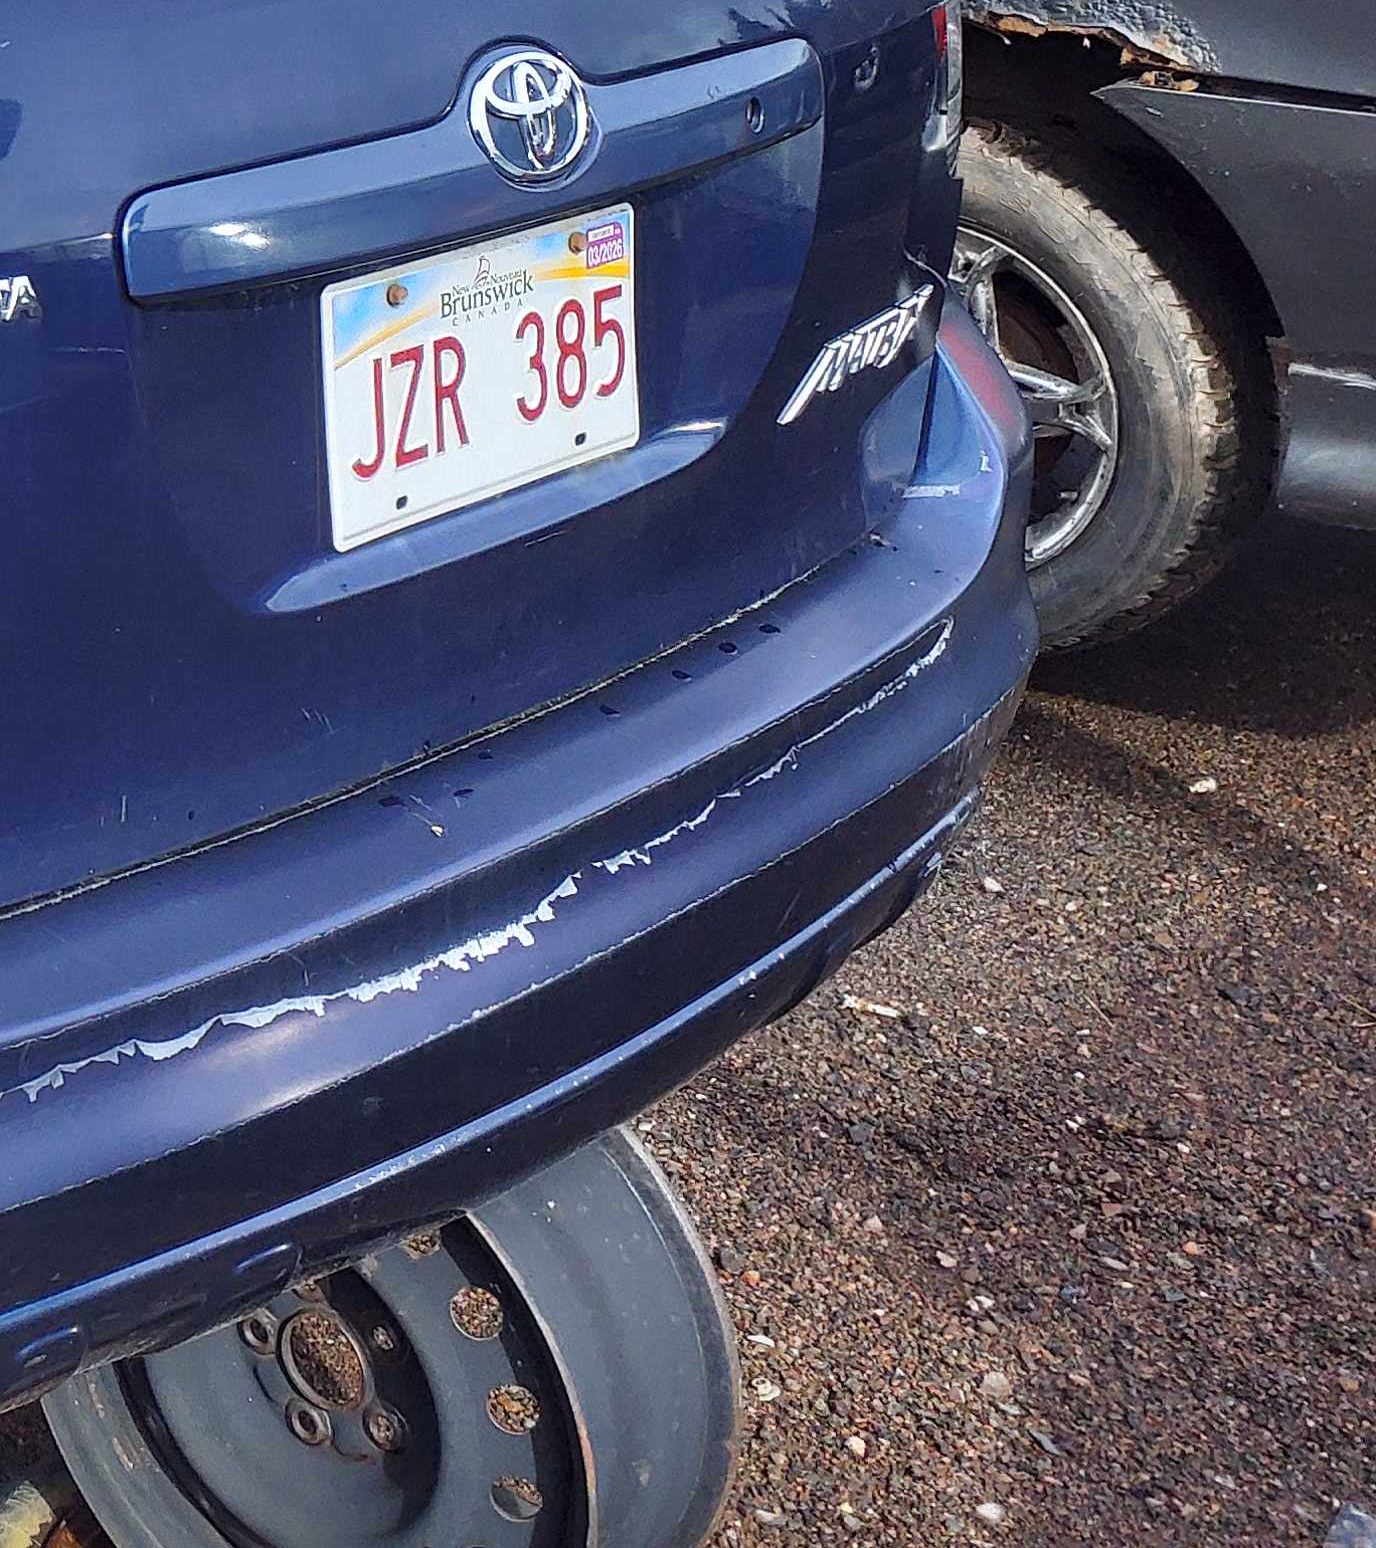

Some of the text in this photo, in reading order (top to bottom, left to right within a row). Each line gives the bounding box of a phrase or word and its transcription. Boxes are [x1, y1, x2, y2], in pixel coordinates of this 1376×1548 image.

[588, 237, 623, 266] 03/2026
[439, 269, 535, 320] Brunswick
[452, 284, 470, 296] New
[452, 298, 524, 327] CANADA
[350, 284, 627, 479] JZR 385
